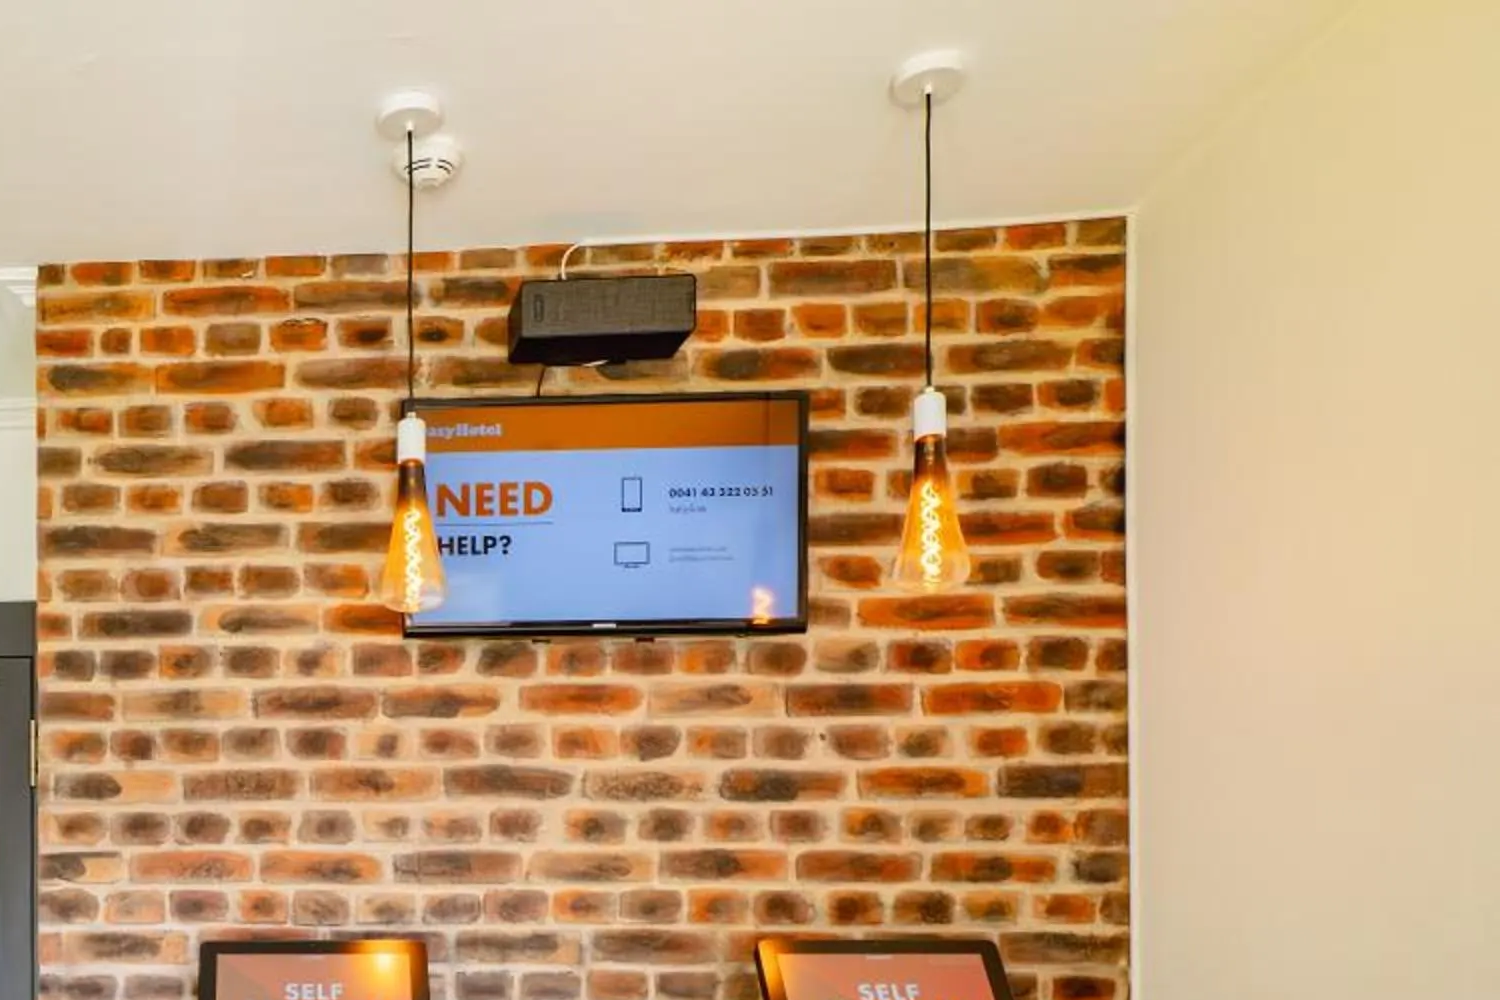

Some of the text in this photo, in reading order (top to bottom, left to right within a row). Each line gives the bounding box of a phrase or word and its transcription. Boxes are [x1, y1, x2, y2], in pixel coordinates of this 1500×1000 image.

[426, 423, 502, 440] asyHotel
[436, 481, 553, 517] NEED
[668, 487, 697, 499] 0041
[437, 534, 512, 556] HELP?
[284, 982, 344, 1000] SELF
[857, 983, 920, 1000] SELF
